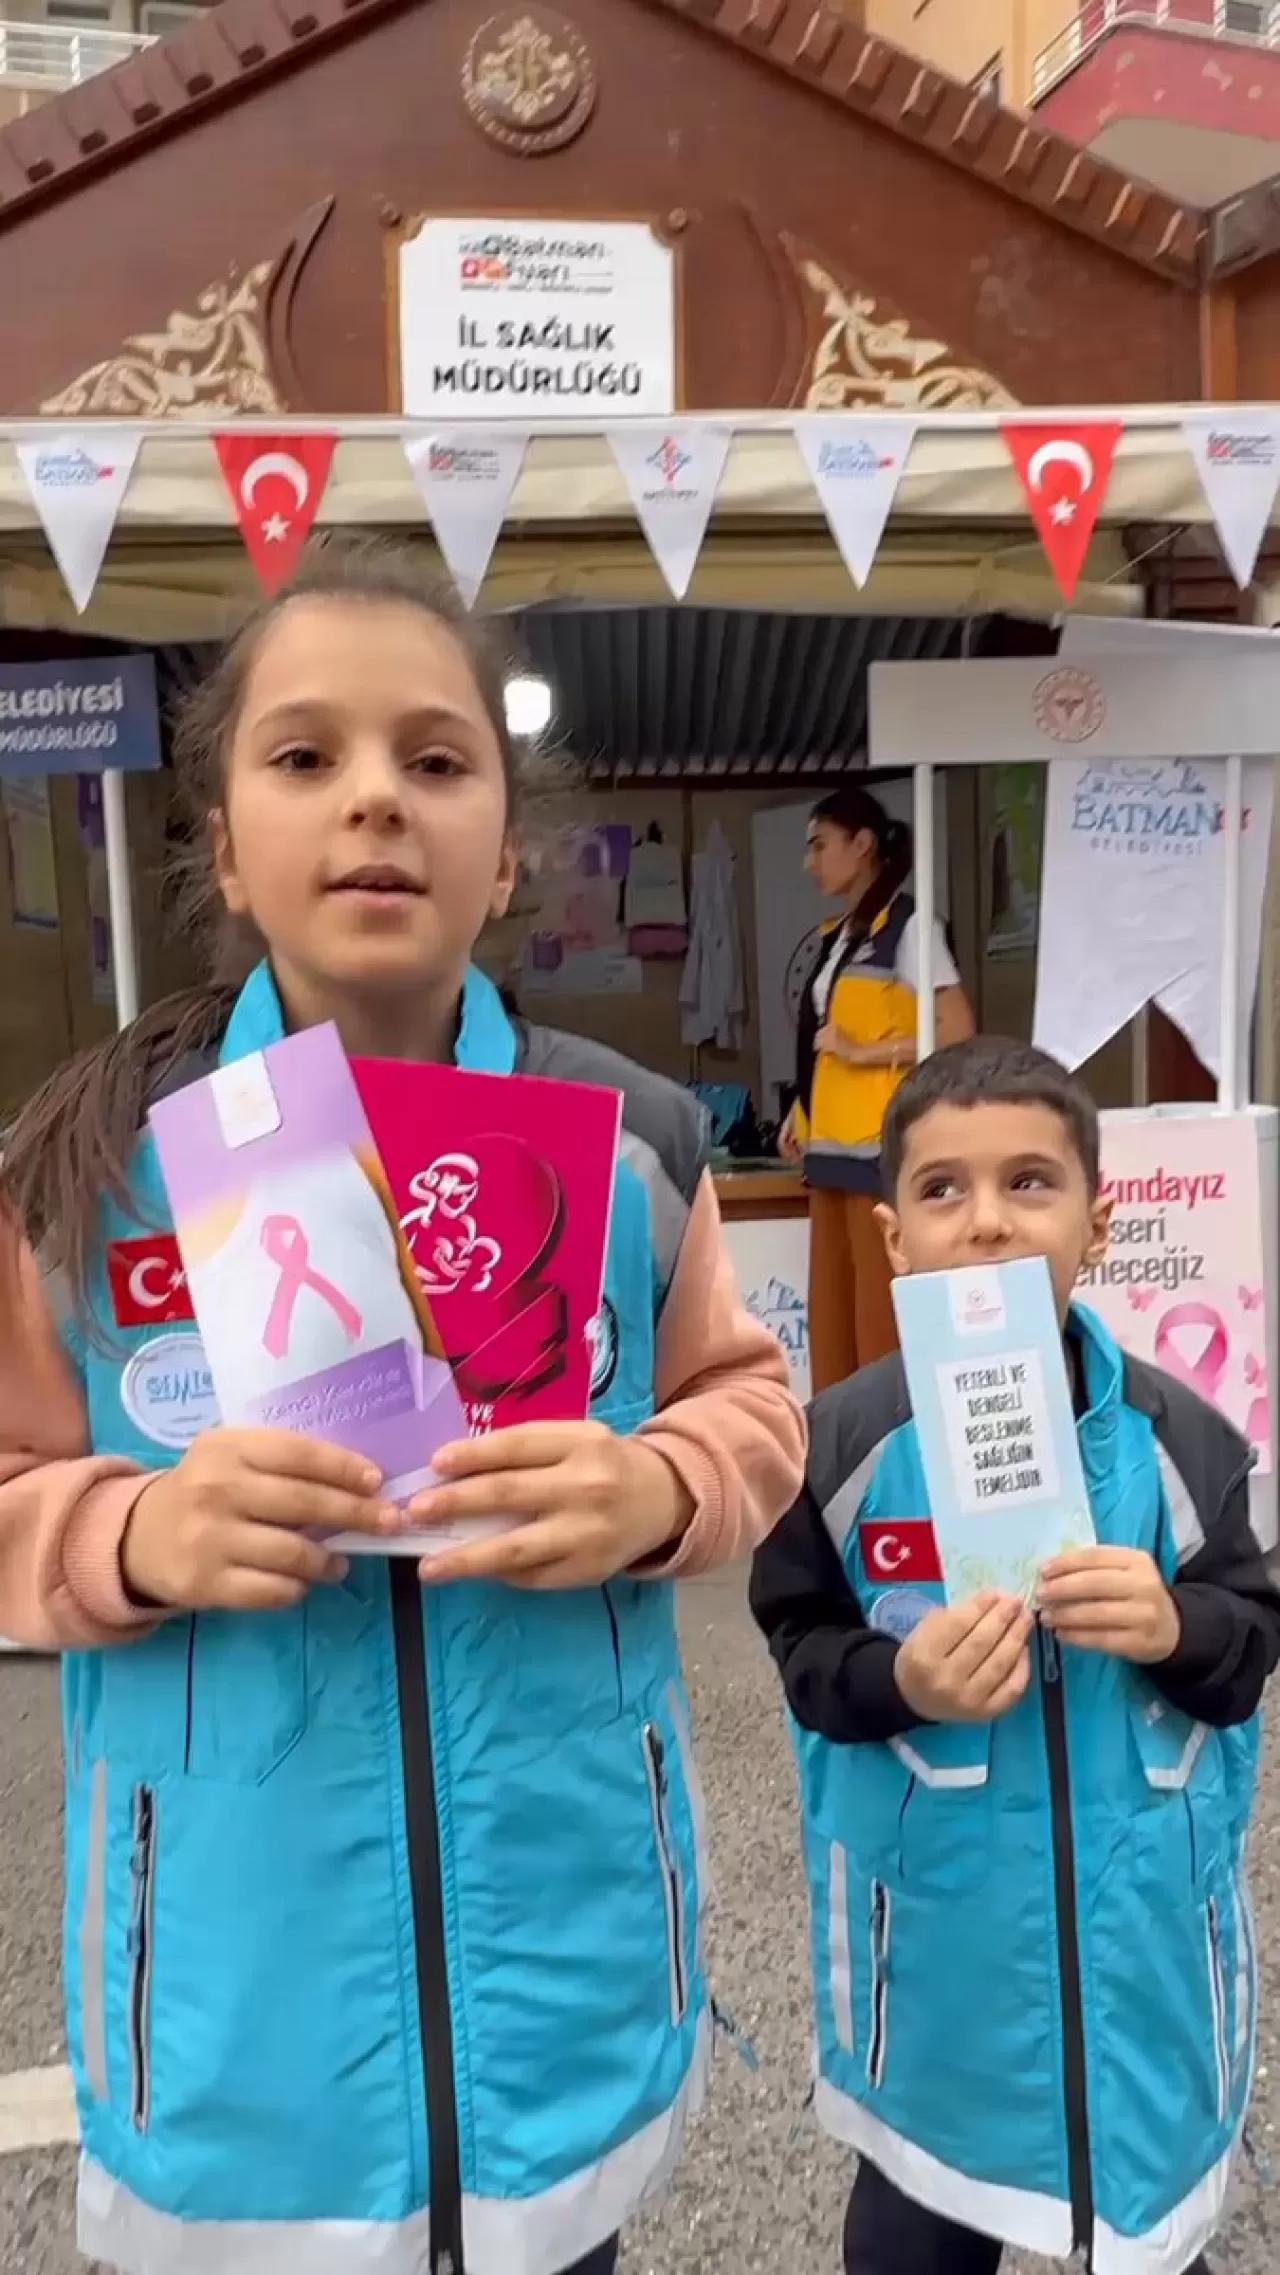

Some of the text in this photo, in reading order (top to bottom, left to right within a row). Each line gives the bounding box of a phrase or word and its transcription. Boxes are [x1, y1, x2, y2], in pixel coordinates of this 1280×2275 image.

[459, 314, 615, 351] İL SAĞLIK
[432, 359, 642, 395] MÜDÜRLÜĞÜ
[1071, 792, 1223, 836] BATMAN
[1109, 1207, 1165, 1244] seri
